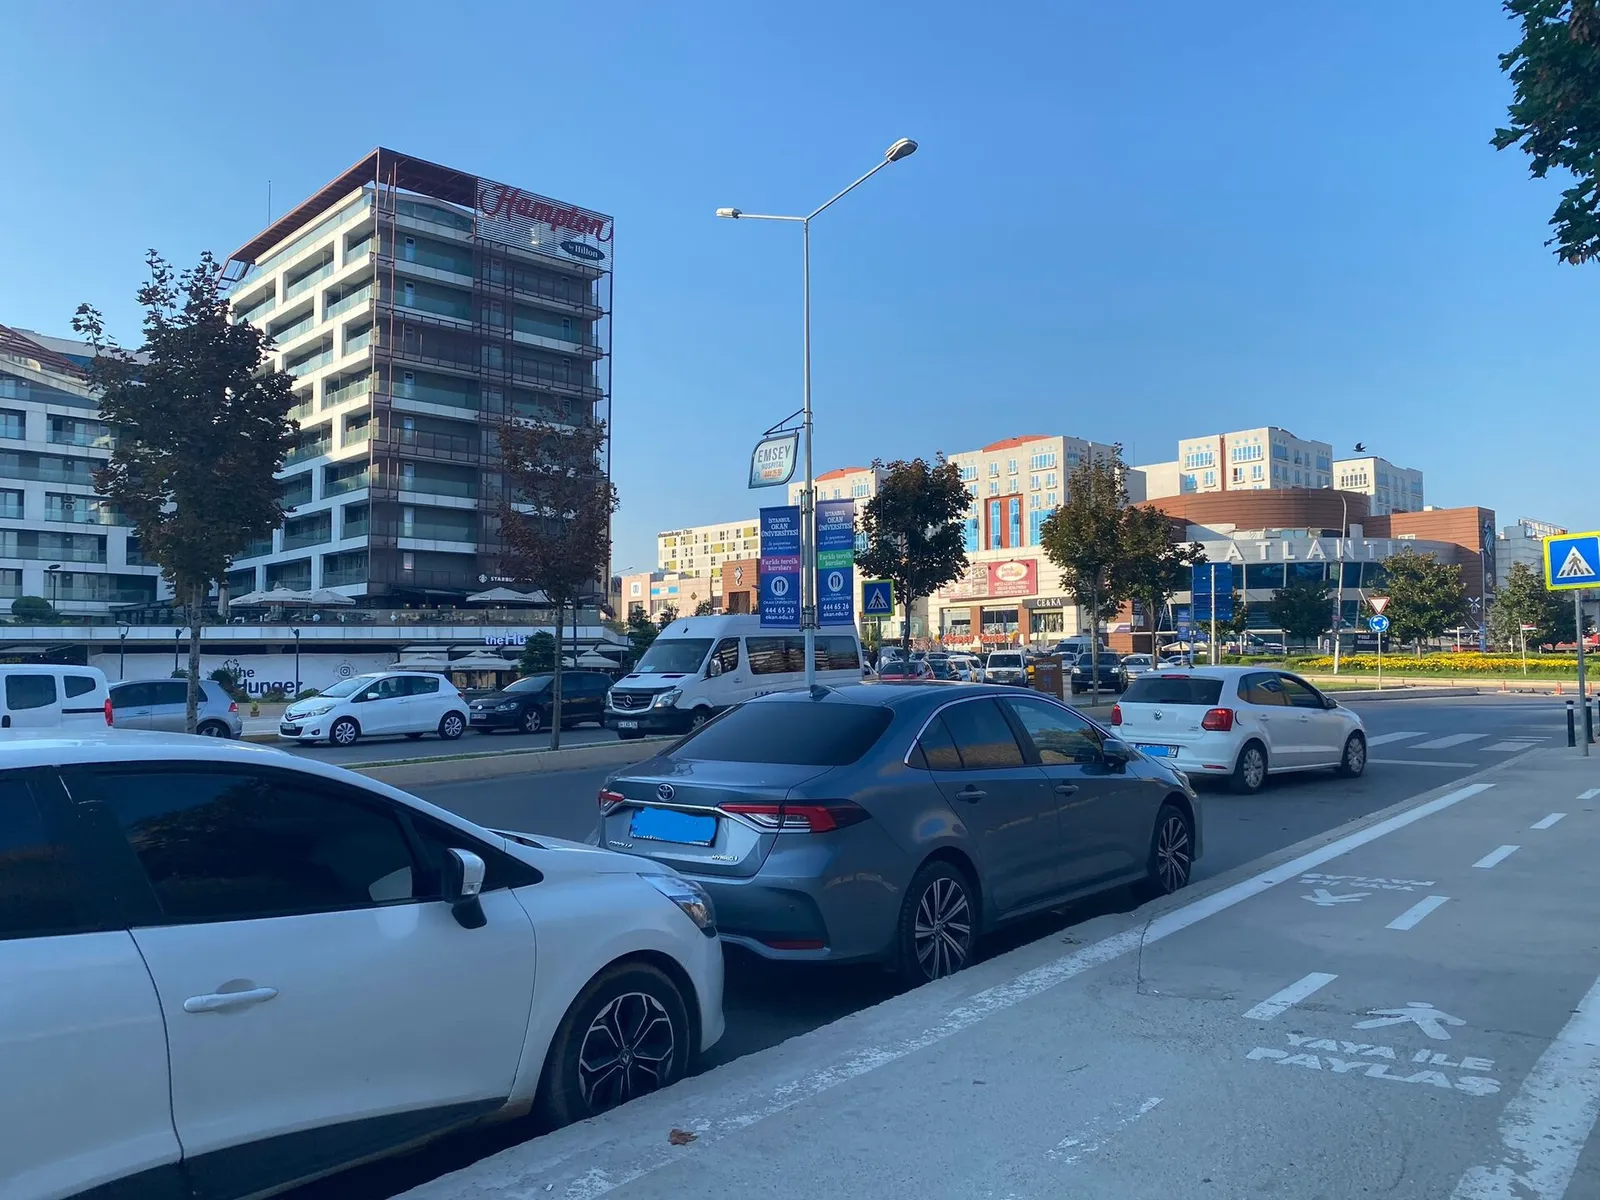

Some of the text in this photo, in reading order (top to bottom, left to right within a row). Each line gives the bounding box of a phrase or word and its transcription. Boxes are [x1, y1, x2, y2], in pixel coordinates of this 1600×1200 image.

[479, 185, 613, 242] Hampton
[575, 245, 598, 258] Hilton
[757, 445, 791, 463] EMSEY
[761, 461, 784, 469] HOSPITAL
[1286, 1033, 1396, 1060] YAYA
